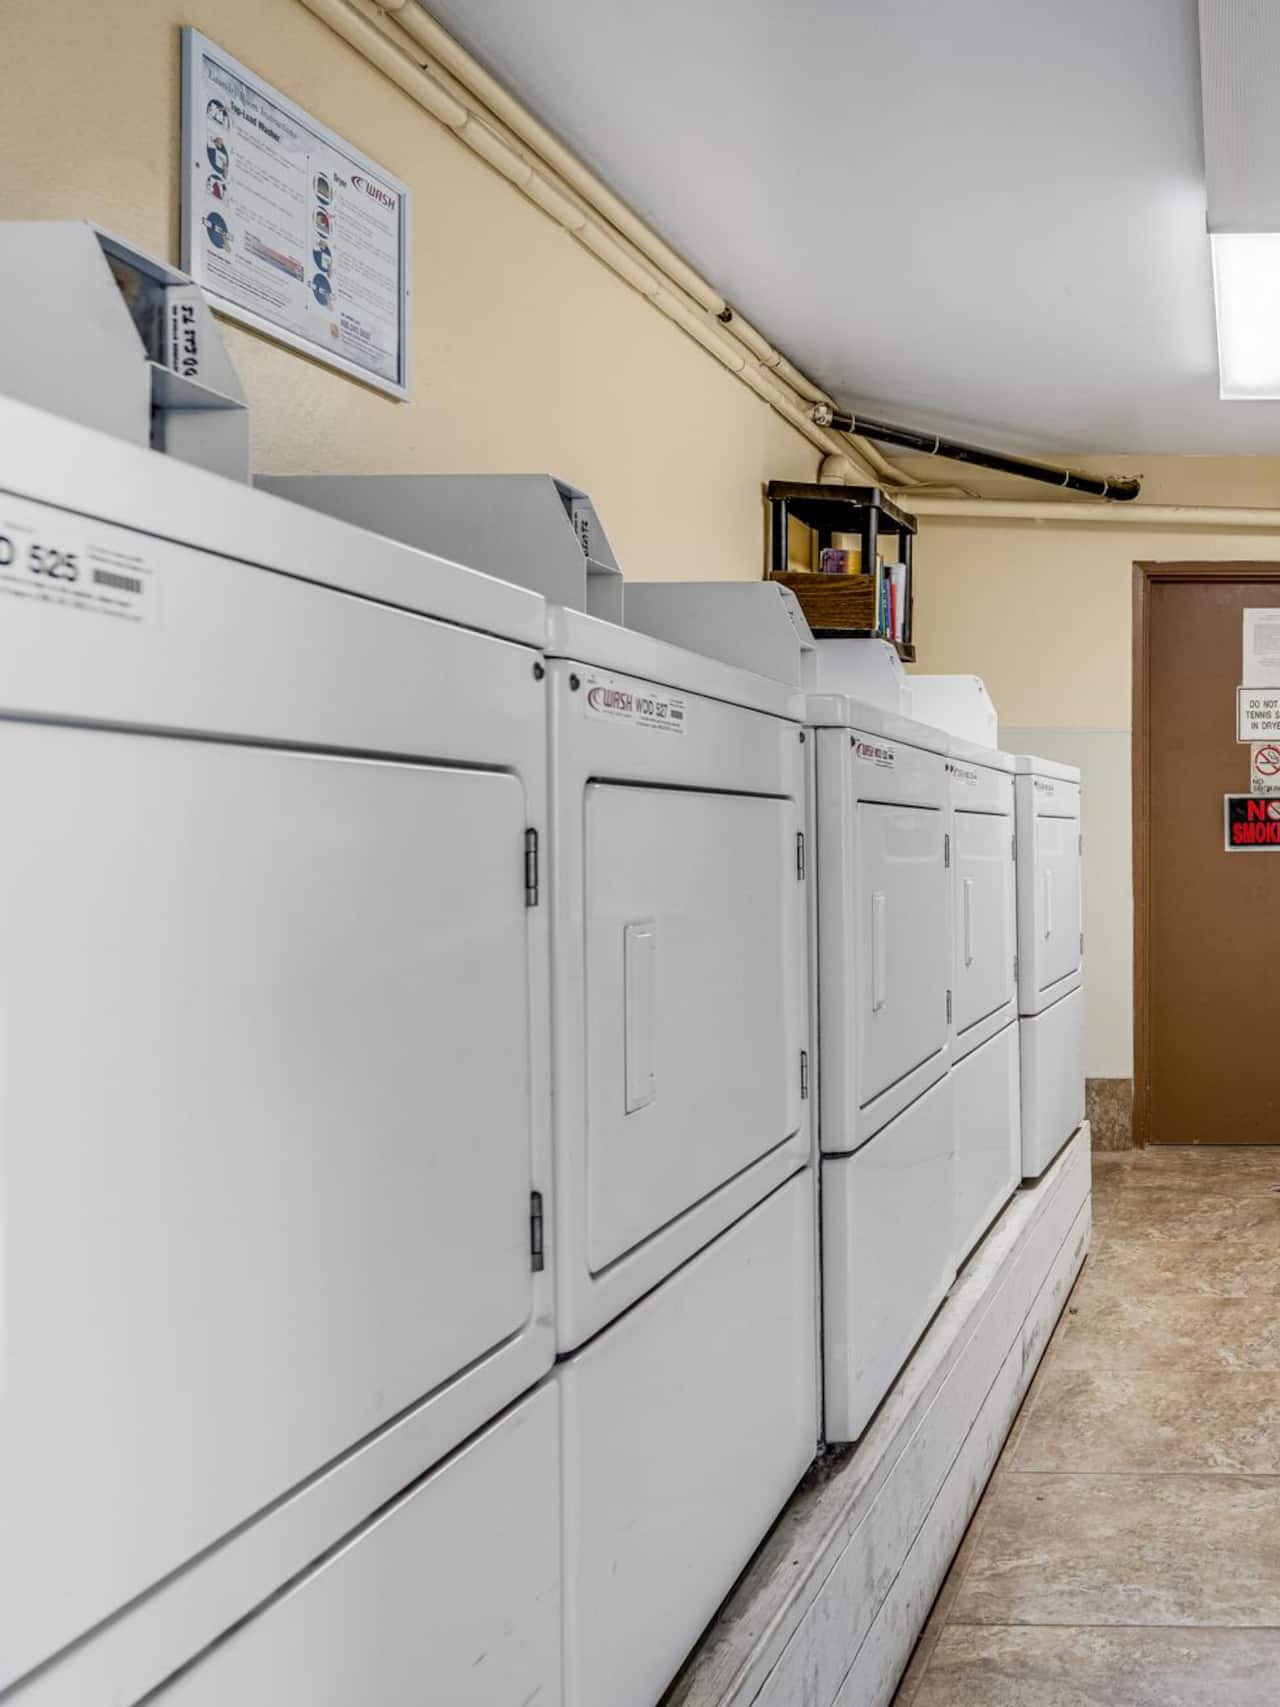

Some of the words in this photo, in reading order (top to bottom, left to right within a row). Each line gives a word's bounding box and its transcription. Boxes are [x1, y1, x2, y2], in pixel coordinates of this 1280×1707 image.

[366, 183, 395, 210] WASH
[29, 544, 79, 582] 525
[602, 688, 633, 713] WASH
[1249, 699, 1260, 709] DO
[1263, 699, 1278, 709] NOT
[1246, 710, 1272, 720] TENNIS
[1250, 721, 1259, 730] IN
[1252, 777, 1264, 785] NO
